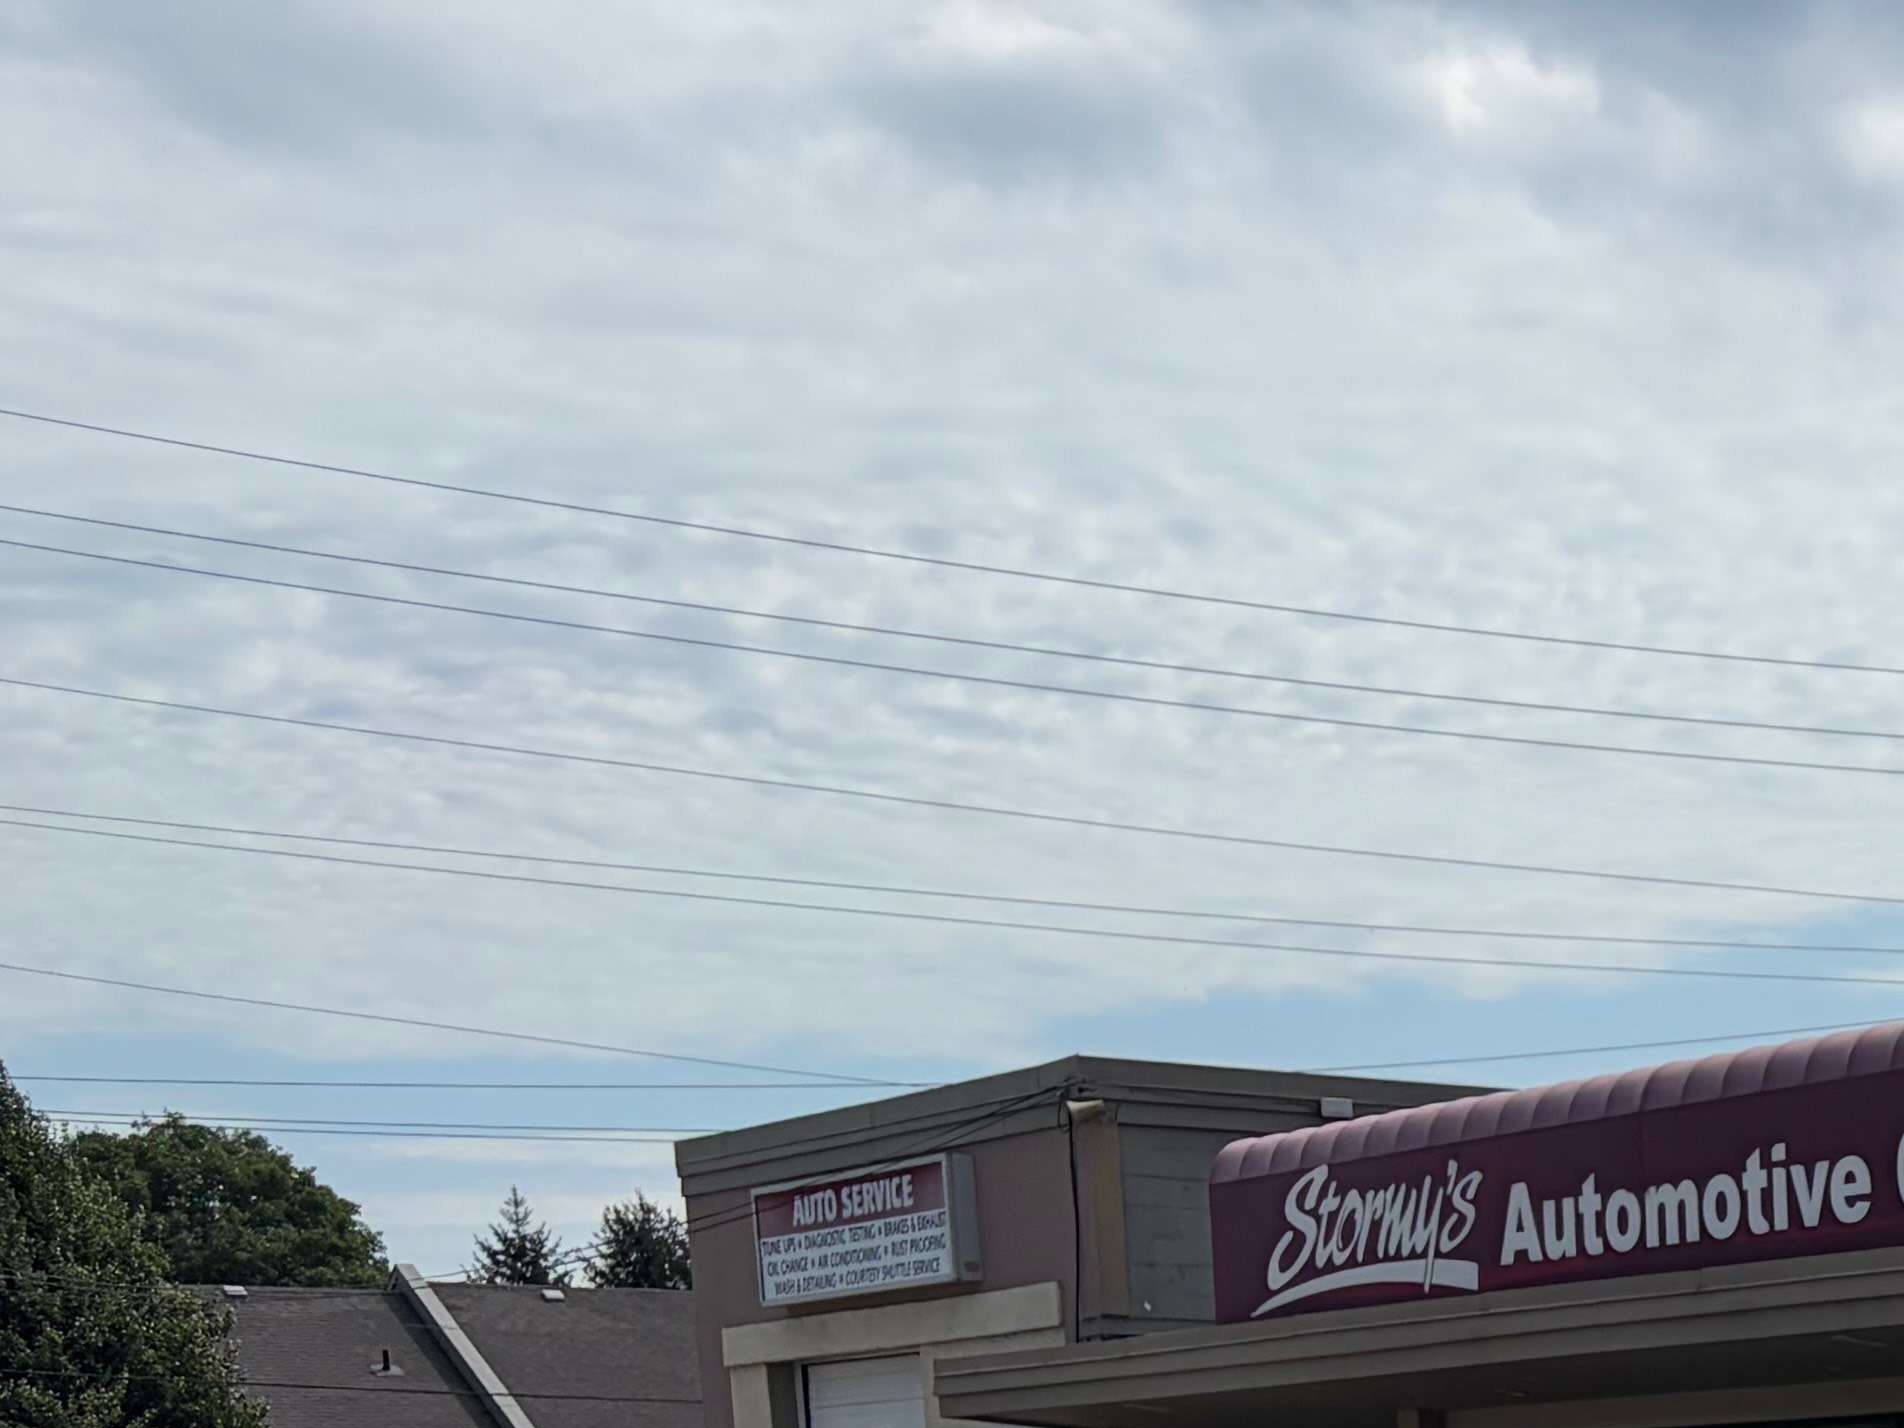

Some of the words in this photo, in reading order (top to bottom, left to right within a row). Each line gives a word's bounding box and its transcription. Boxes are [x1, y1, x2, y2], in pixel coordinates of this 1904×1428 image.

[792, 1188, 838, 1227] AUTO
[841, 1173, 914, 1219] SERVICE
[1266, 1158, 1484, 1293] Stormy's
[1499, 1140, 1874, 1266] Automotive
